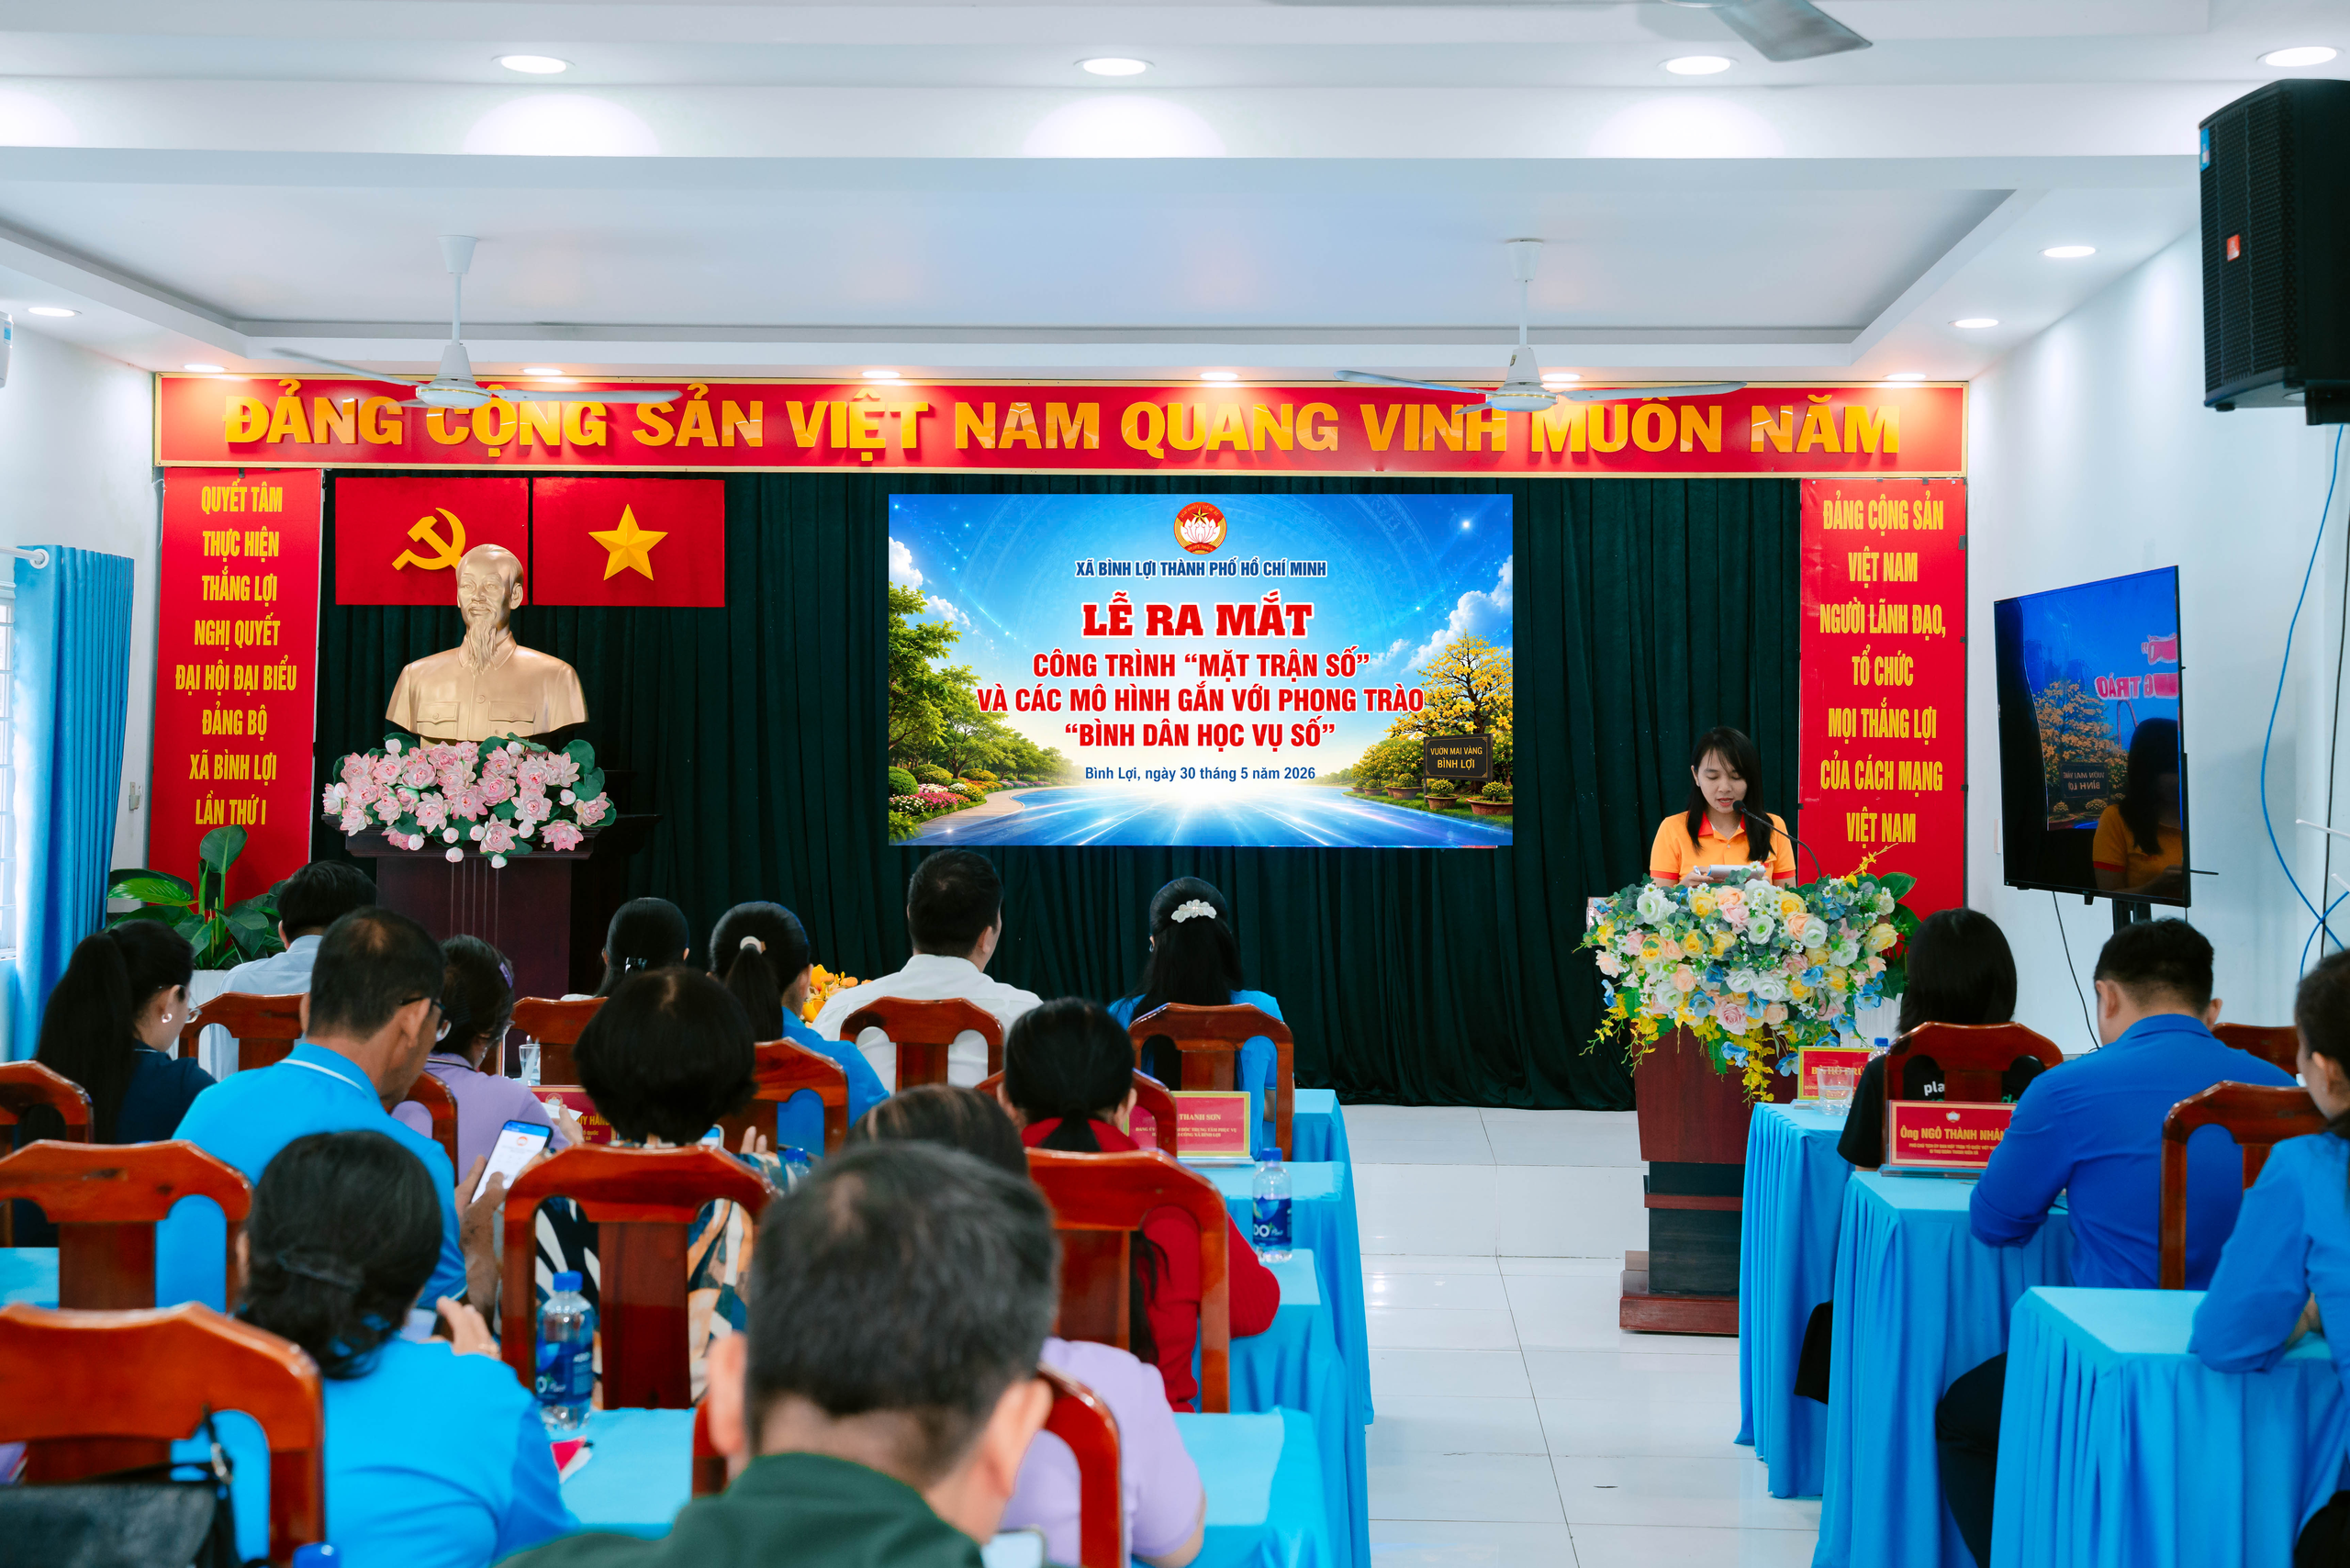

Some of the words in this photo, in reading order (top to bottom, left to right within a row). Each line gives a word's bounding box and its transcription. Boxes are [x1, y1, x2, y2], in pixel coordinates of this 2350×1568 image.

[223, 379, 404, 447] ĐẢNG
[426, 384, 607, 457] CỘNG
[632, 383, 763, 449] SẢN
[786, 389, 929, 462] VIỆT
[955, 402, 1100, 450] NAM
[1121, 401, 1339, 459] QUANG
[1360, 404, 1507, 453] VINH
[1531, 397, 1722, 453] MUÔN
[1751, 395, 1899, 454] NĂM
[200, 477, 248, 515] QUYẾT
[250, 480, 284, 513] TÂM
[1822, 489, 1864, 531] ĐẢNG
[1867, 493, 1909, 537] CỘNG
[1912, 489, 1944, 531] SẢN
[202, 528, 241, 563] THỰC
[243, 525, 280, 563] HIỆN
[201, 565, 251, 601] THẮNG
[253, 573, 278, 608] LỢI
[1076, 559, 1094, 577] XÃ
[1099, 558, 1131, 577] BÌNH
[1136, 560, 1156, 579] LỢI
[1160, 557, 1205, 577] THÀNH
[1209, 556, 1237, 577] PHỐ
[1241, 556, 1259, 577] HỒ
[1263, 558, 1286, 577] CHÍ
[1290, 561, 1326, 577] MINH
[1847, 545, 1880, 588] VIỆT
[1883, 552, 1919, 582] NAM
[194, 619, 230, 652] NGHỊ
[234, 611, 281, 649] QUYẾT
[1083, 591, 1133, 636] LỄ
[1146, 605, 1203, 636] RA
[1216, 591, 1313, 636] MẮT
[1819, 596, 1865, 634] NGƯỜI
[1869, 598, 1908, 634] LÃNH
[1911, 604, 1946, 642] ĐẠO,
[174, 664, 201, 696] ĐẠI
[205, 658, 230, 697] HỘI
[233, 665, 259, 697] ĐẠI
[263, 654, 297, 691] BIỂU
[1034, 649, 1097, 678] CÔNG
[1104, 648, 1175, 677] TRÌNH
[1184, 650, 1250, 684] “MẶT
[1256, 648, 1317, 684] TRẬN
[1326, 645, 1370, 678] SỐ”
[1852, 644, 1871, 687] TỔ
[1874, 649, 1914, 687] CHỨC
[977, 683, 1008, 711] VÀ
[1015, 683, 1062, 712] CÁC
[1069, 683, 1107, 712] MÔ
[1114, 683, 1169, 711] HÌNH
[1178, 681, 1224, 712] GẮN
[1230, 681, 1270, 712] VỚI
[1279, 688, 1356, 712] PHONG
[1363, 683, 1424, 712] TRÀO
[202, 700, 243, 735] ĐẢNG
[247, 704, 267, 742] BỘ
[1065, 718, 1135, 746] “BÌNH
[1143, 718, 1189, 746] DÂN
[1197, 723, 1245, 752] HỌC
[1251, 723, 1282, 752] VỤ
[1291, 715, 1335, 747] SỐ”
[1828, 707, 1857, 745] MỌI
[1860, 697, 1909, 739] THẮNG
[1913, 705, 1937, 745] LỢI
[188, 748, 209, 780] XÃ
[213, 748, 251, 780] BÌNH
[253, 752, 277, 786] LỢI
[1430, 746, 1449, 756] VƯỜN
[1449, 746, 1462, 756] MAI
[1463, 745, 1483, 755] VÀNG
[1437, 757, 1458, 768] BÌNH
[1460, 758, 1475, 770] LỢI
[1085, 767, 1113, 780] Bình
[1118, 767, 1140, 783] Lợi,
[1145, 769, 1176, 783] ngày
[1180, 767, 1196, 780] 30
[1200, 766, 1237, 783] tháng
[1240, 767, 1248, 780] 5
[1252, 766, 1280, 780] năm
[1284, 767, 1315, 780] 2026
[1820, 749, 1851, 790] CỦA
[1854, 754, 1895, 790] CÁCH
[1898, 760, 1943, 798] MẠNG
[195, 790, 225, 825] LẦN
[229, 793, 260, 825] THỨ
[261, 799, 266, 825] I
[1846, 806, 1878, 849] VIỆT
[1881, 812, 1917, 844] NAM
[1900, 1125, 1919, 1141] Ông
[1921, 1126, 1942, 1139] NGÔ
[1944, 1126, 1977, 1140] THÀNH
